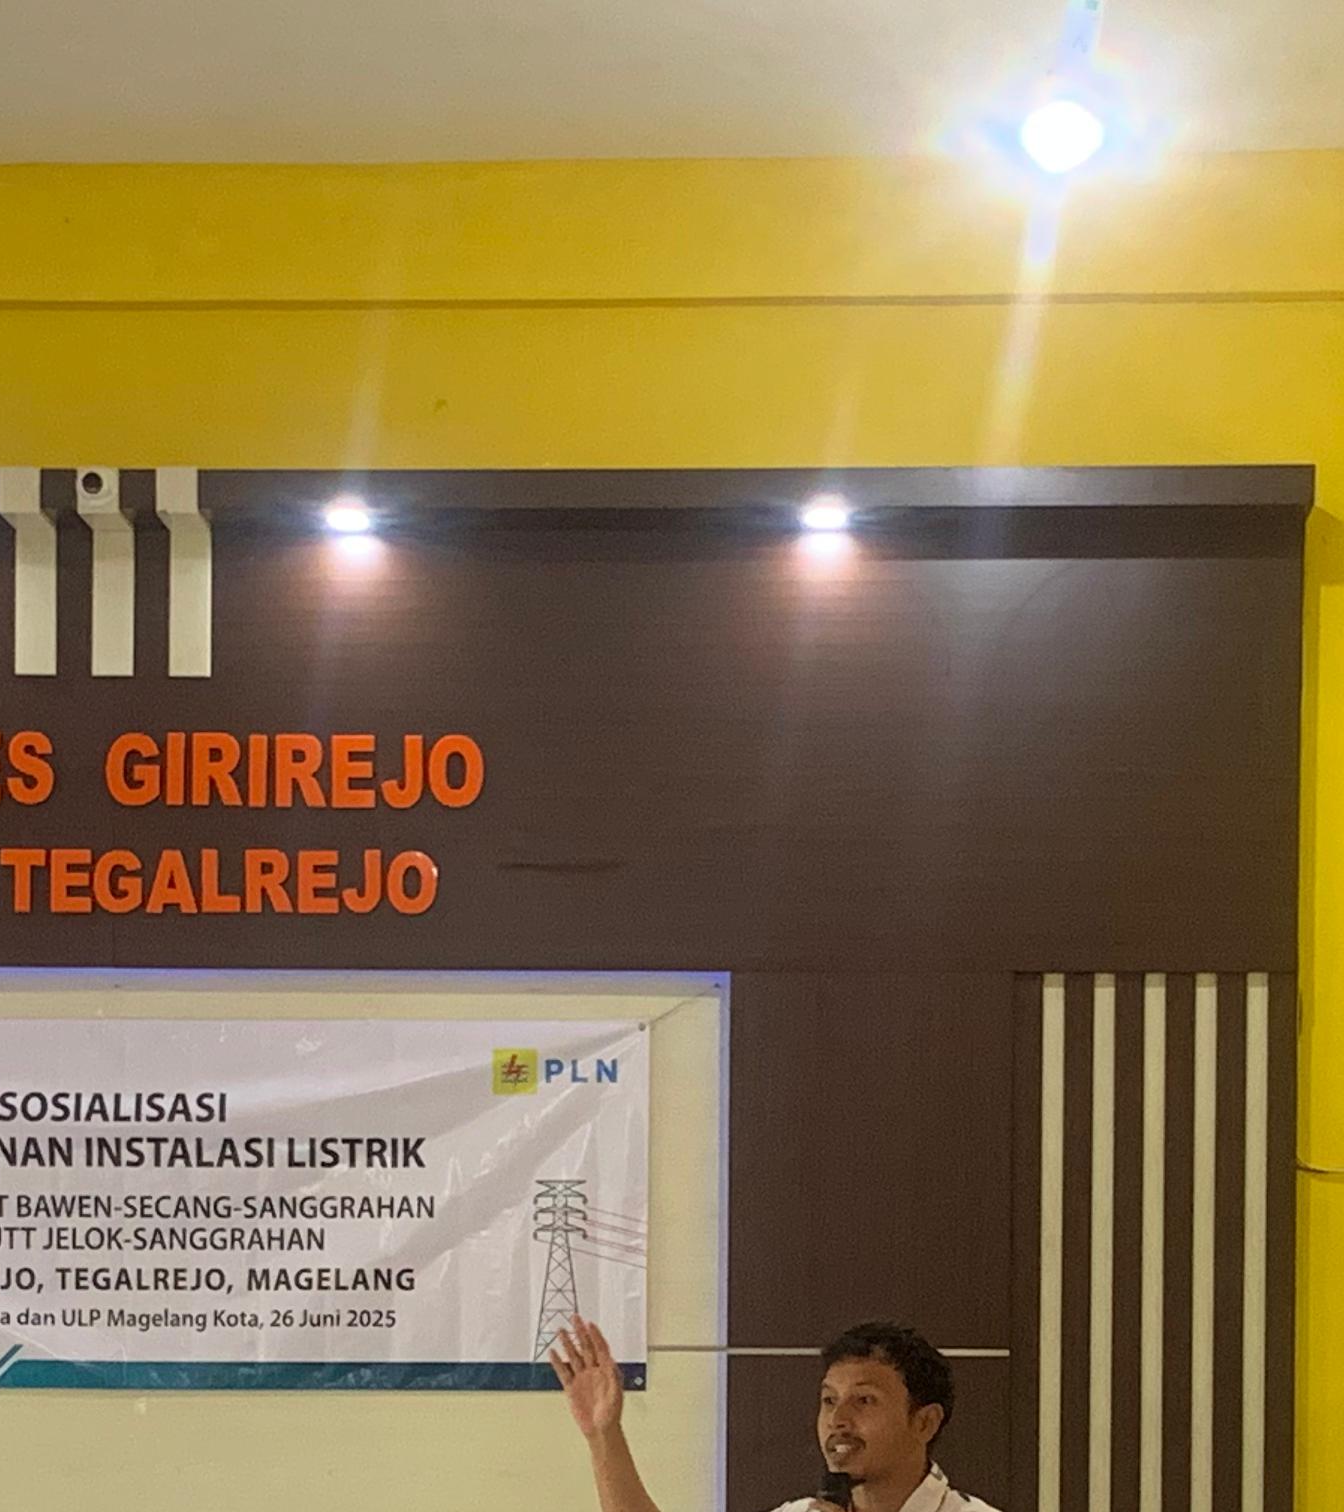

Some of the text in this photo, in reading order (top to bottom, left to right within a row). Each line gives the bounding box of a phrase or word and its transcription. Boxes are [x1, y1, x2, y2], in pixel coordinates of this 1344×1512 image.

[105, 732, 485, 808] GIRIREJO
[0, 848, 439, 914] TEGALREJO
[544, 1059, 618, 1083] PLN
[85, 1137, 275, 1168] INSTALASI
[287, 1138, 426, 1168] LISTRIK
[17, 1195, 434, 1218] BAWEN-SECANG-SANGGRAHAN
[42, 1228, 325, 1251] JELOK-SANGGRAHAN
[56, 1268, 234, 1294] TEGALREJO,
[247, 1269, 416, 1291] MAGELANG
[17, 1308, 56, 1326] dan
[62, 1308, 101, 1326] ULP
[107, 1308, 207, 1332] Magelang
[214, 1310, 264, 1331] Kota,
[270, 1310, 294, 1328] 26
[299, 1309, 341, 1331] Juni
[348, 1310, 397, 1328] 2025
